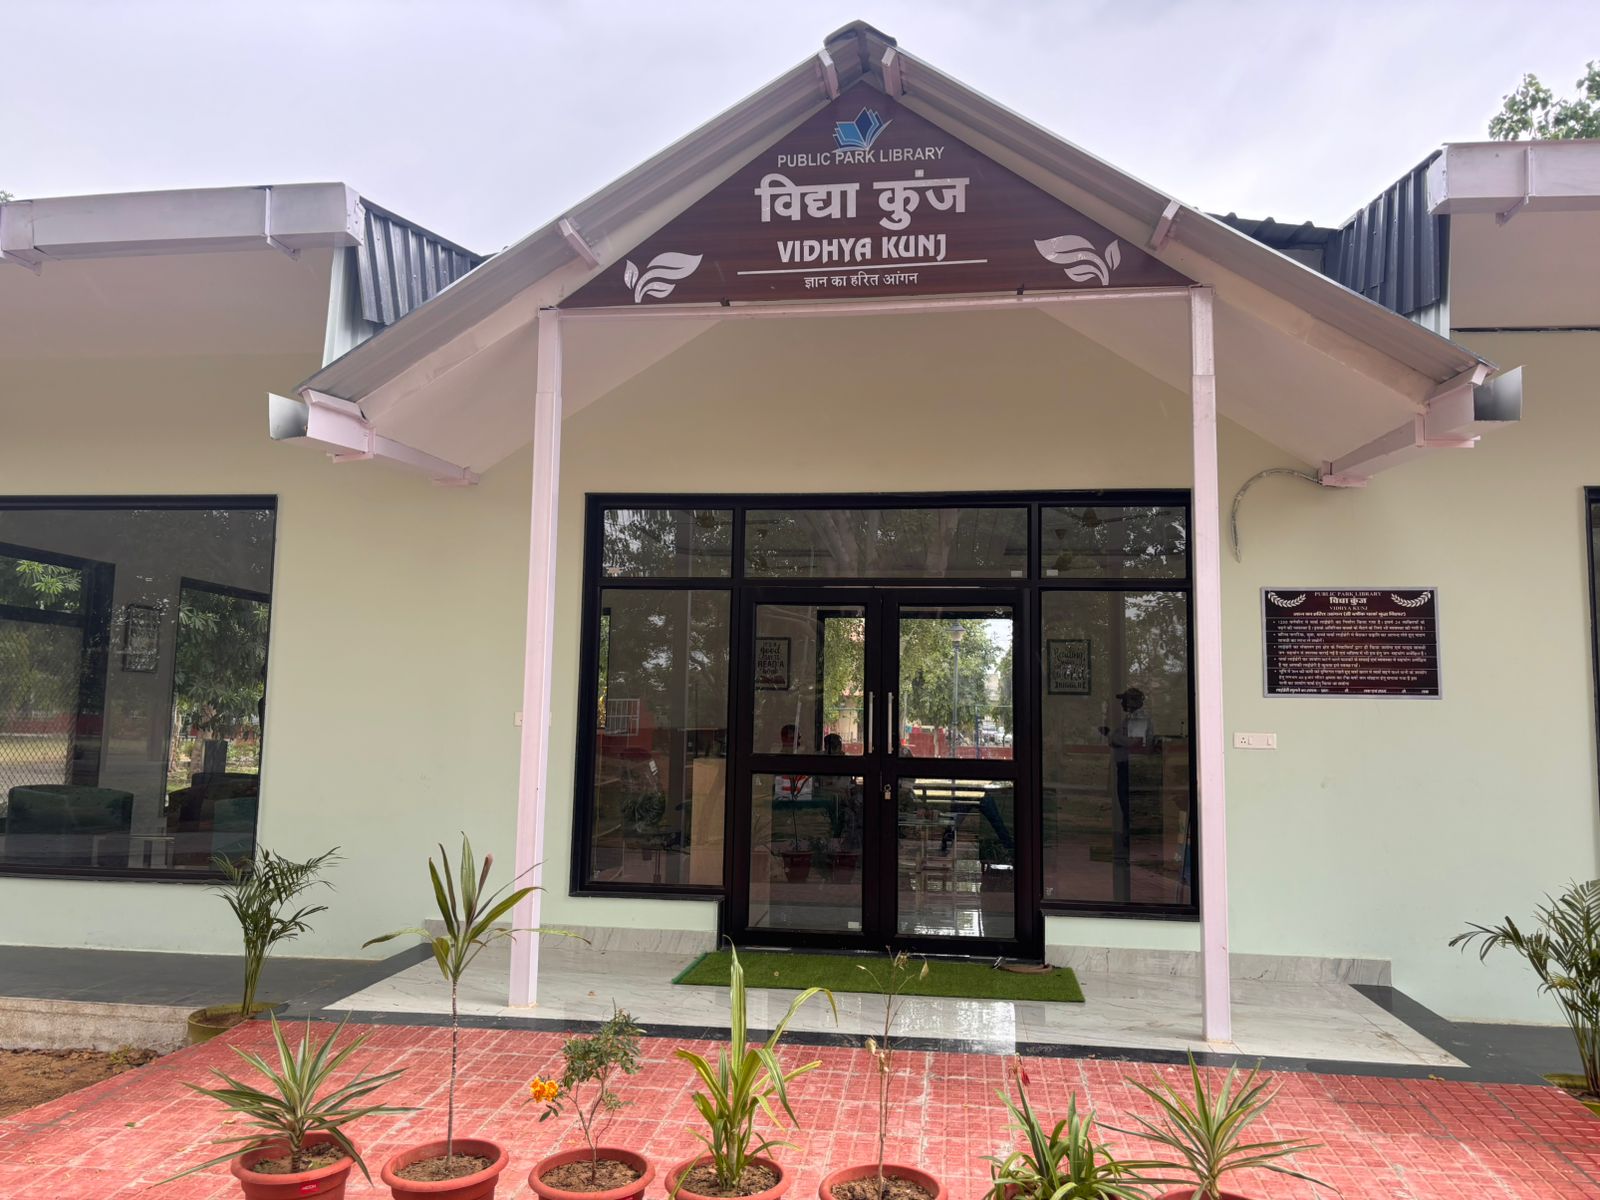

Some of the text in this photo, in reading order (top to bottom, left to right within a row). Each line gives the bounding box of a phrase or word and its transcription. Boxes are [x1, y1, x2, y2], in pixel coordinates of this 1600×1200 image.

[778, 146, 945, 168] PUBLIC PARK LIBRARY
[754, 169, 970, 230] विद्या कुंज
[777, 234, 947, 264] VIDHYA KUNJ
[804, 270, 919, 289] ज्ञान का हरित आंगन
